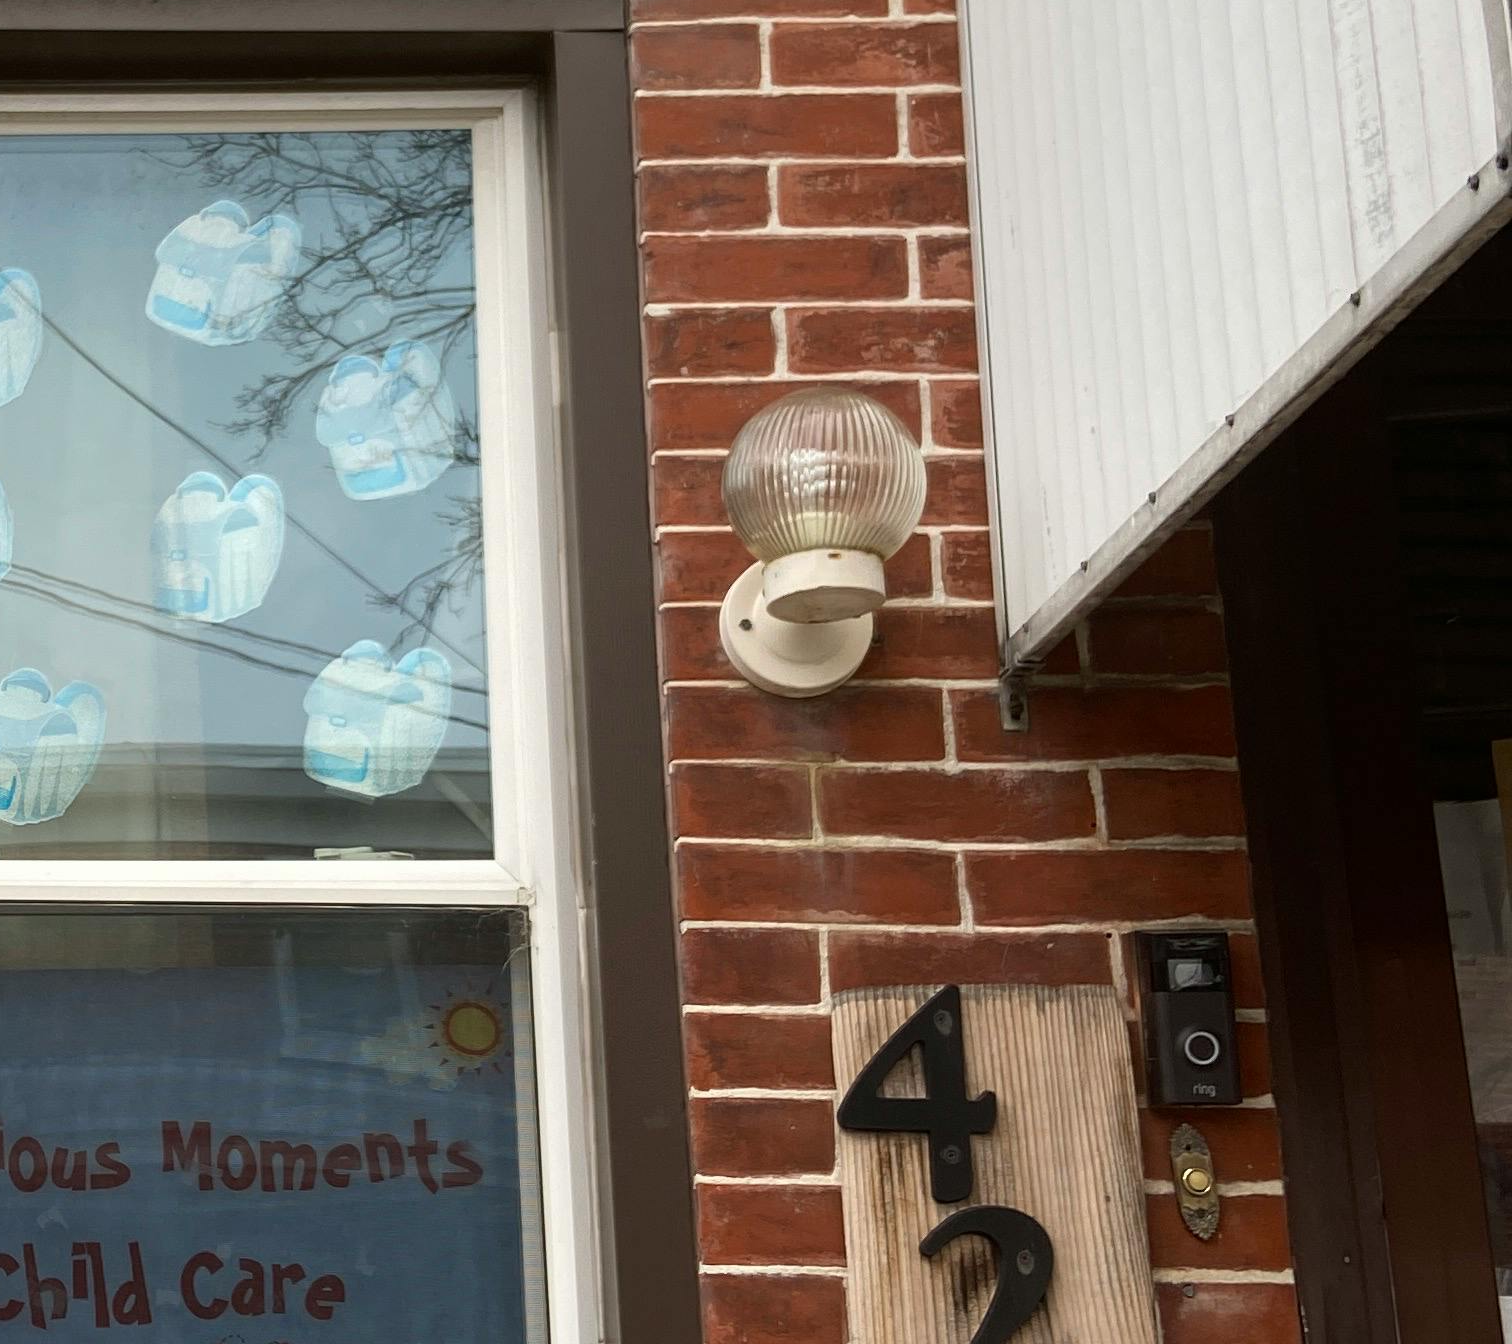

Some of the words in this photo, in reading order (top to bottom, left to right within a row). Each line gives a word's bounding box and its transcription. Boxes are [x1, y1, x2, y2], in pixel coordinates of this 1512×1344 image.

[1193, 1083, 1216, 1097] ring
[160, 1117, 485, 1195] Moments
[180, 1250, 347, 1321] Care
